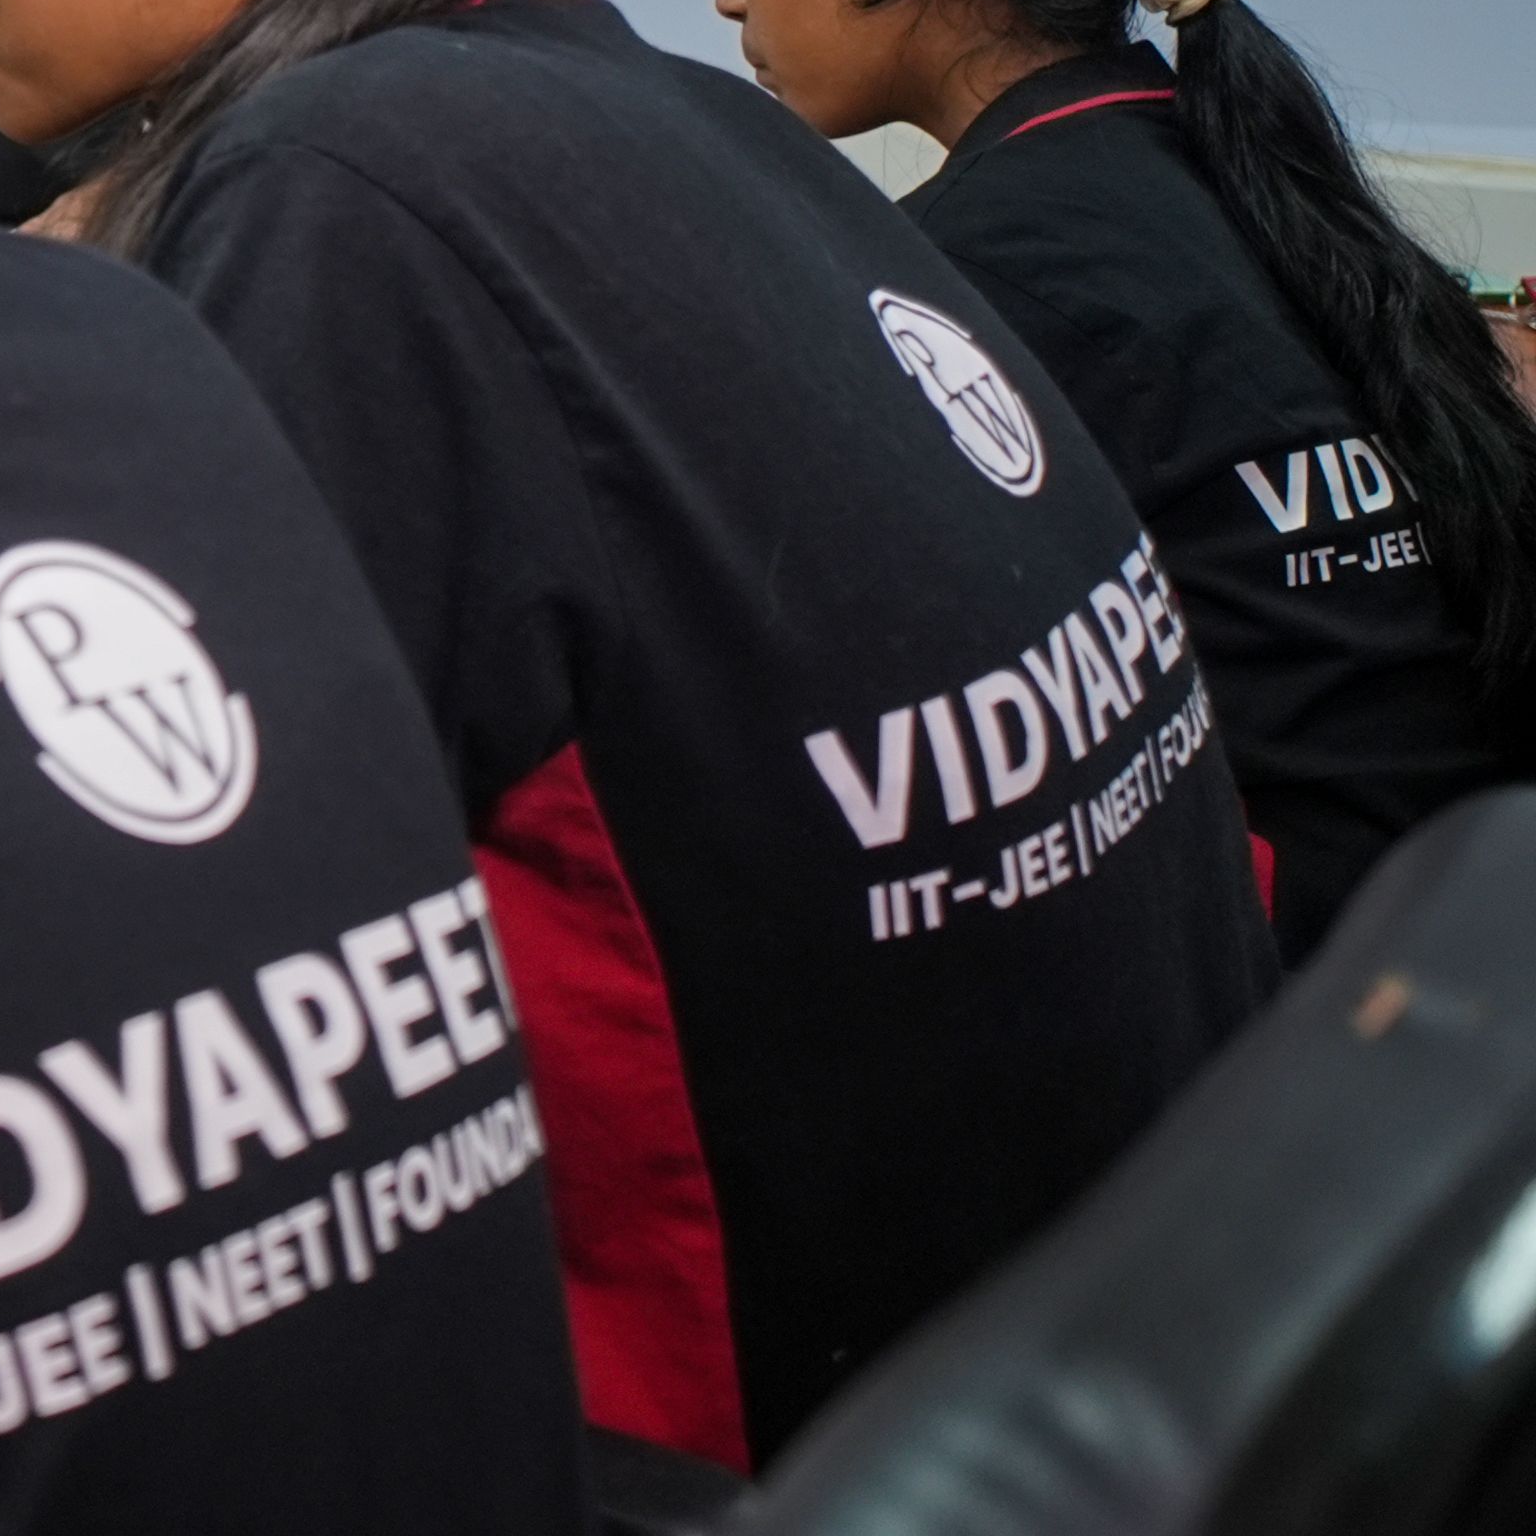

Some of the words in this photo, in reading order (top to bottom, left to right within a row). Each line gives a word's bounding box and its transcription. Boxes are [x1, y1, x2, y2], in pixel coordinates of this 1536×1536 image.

[1233, 433, 1419, 534] VID
[1285, 529, 1420, 587] IIT-JEE
[868, 820, 1073, 942] IIT-JEE
[1088, 751, 1150, 856] NEET
[167, 1197, 332, 1351] NEET
